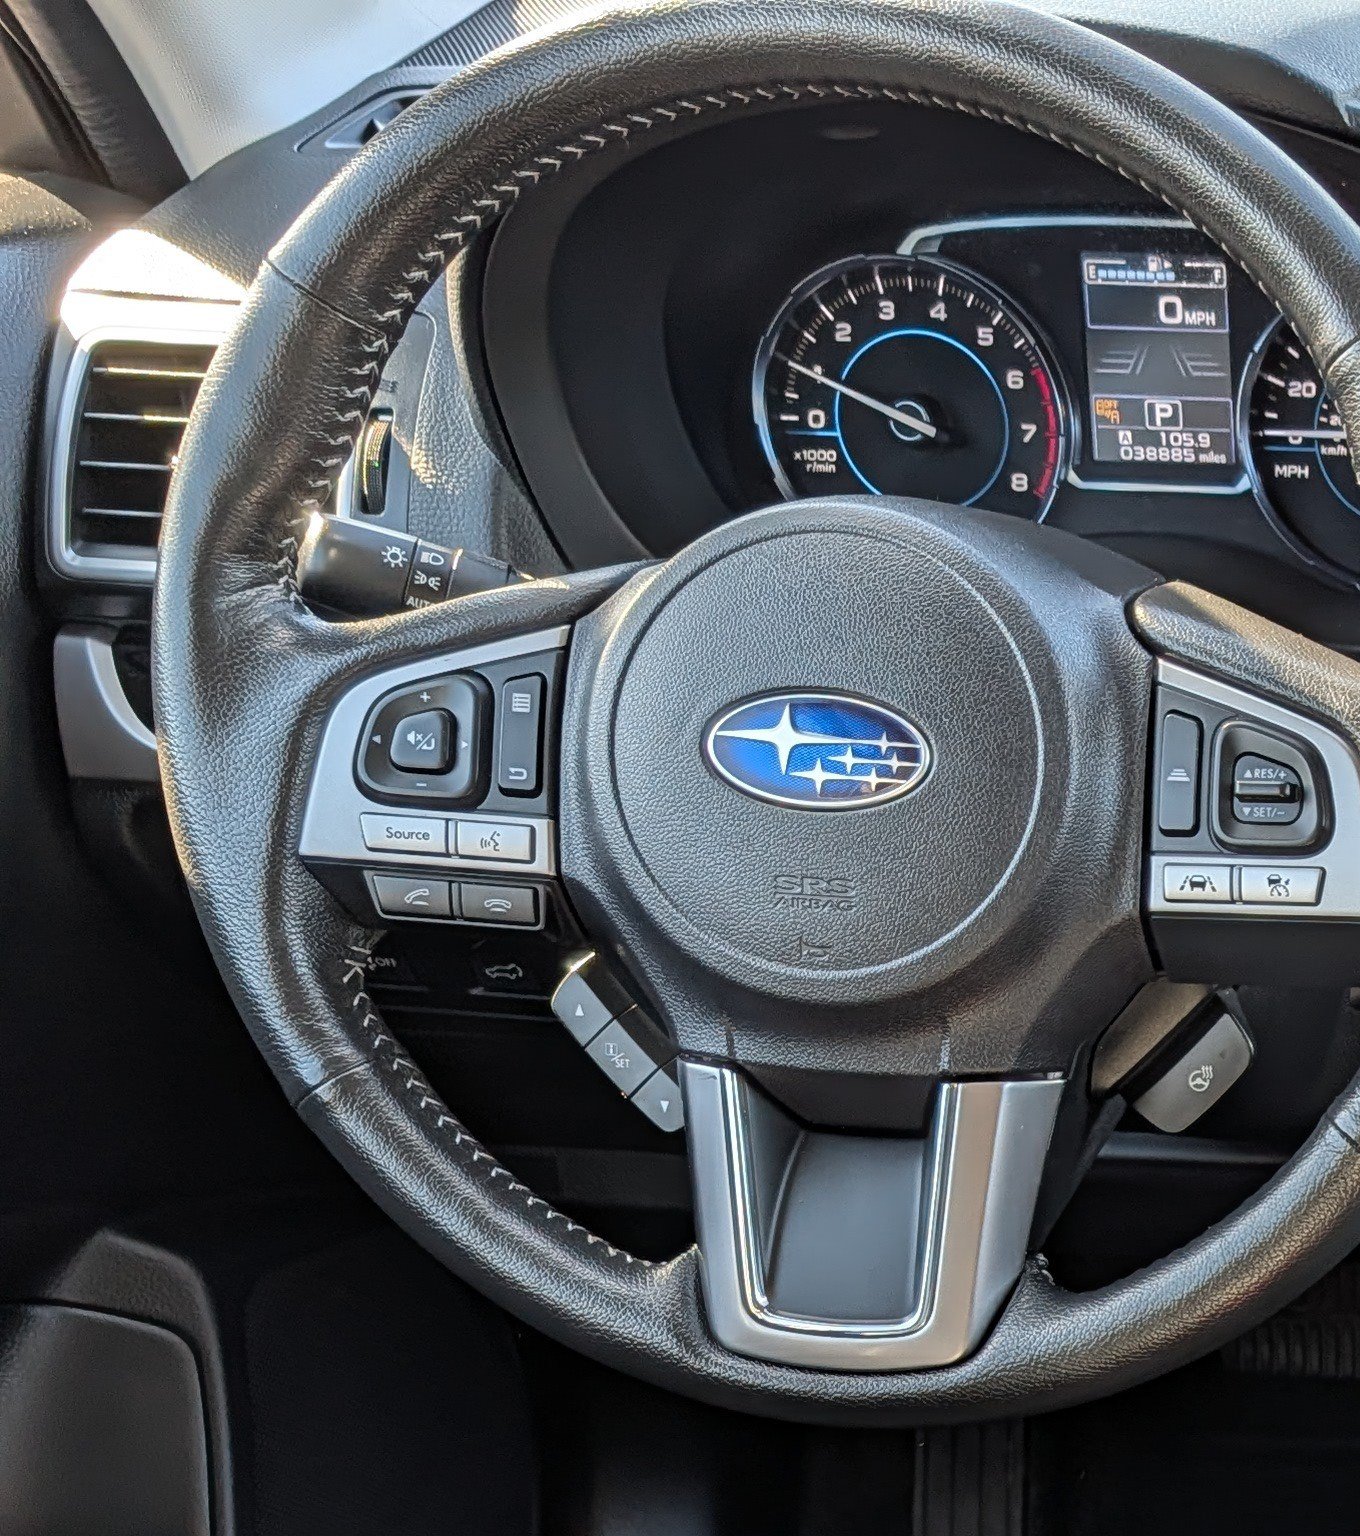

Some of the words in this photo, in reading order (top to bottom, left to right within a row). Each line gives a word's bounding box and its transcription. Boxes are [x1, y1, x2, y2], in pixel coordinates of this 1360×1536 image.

[1088, 264, 1096, 279] E
[1215, 268, 1222, 281] F
[878, 301, 896, 321] 3
[929, 302, 948, 322] 4
[1158, 295, 1183, 325] 0
[1184, 310, 1216, 327] MPH
[834, 322, 852, 342] 2
[977, 327, 994, 347] 5
[1006, 369, 1024, 390] 6
[1287, 380, 1317, 399] 20
[807, 409, 826, 429] 0
[1154, 403, 1173, 427] P
[1020, 424, 1038, 444] 7
[1160, 431, 1211, 448] 105.9
[1119, 446, 1195, 461] 038885
[1199, 449, 1227, 464] miles
[806, 461, 837, 474] r/min
[1274, 464, 1310, 480] MPH
[1010, 472, 1028, 493] 8
[385, 825, 431, 842] Source
[774, 875, 855, 896] SRS
